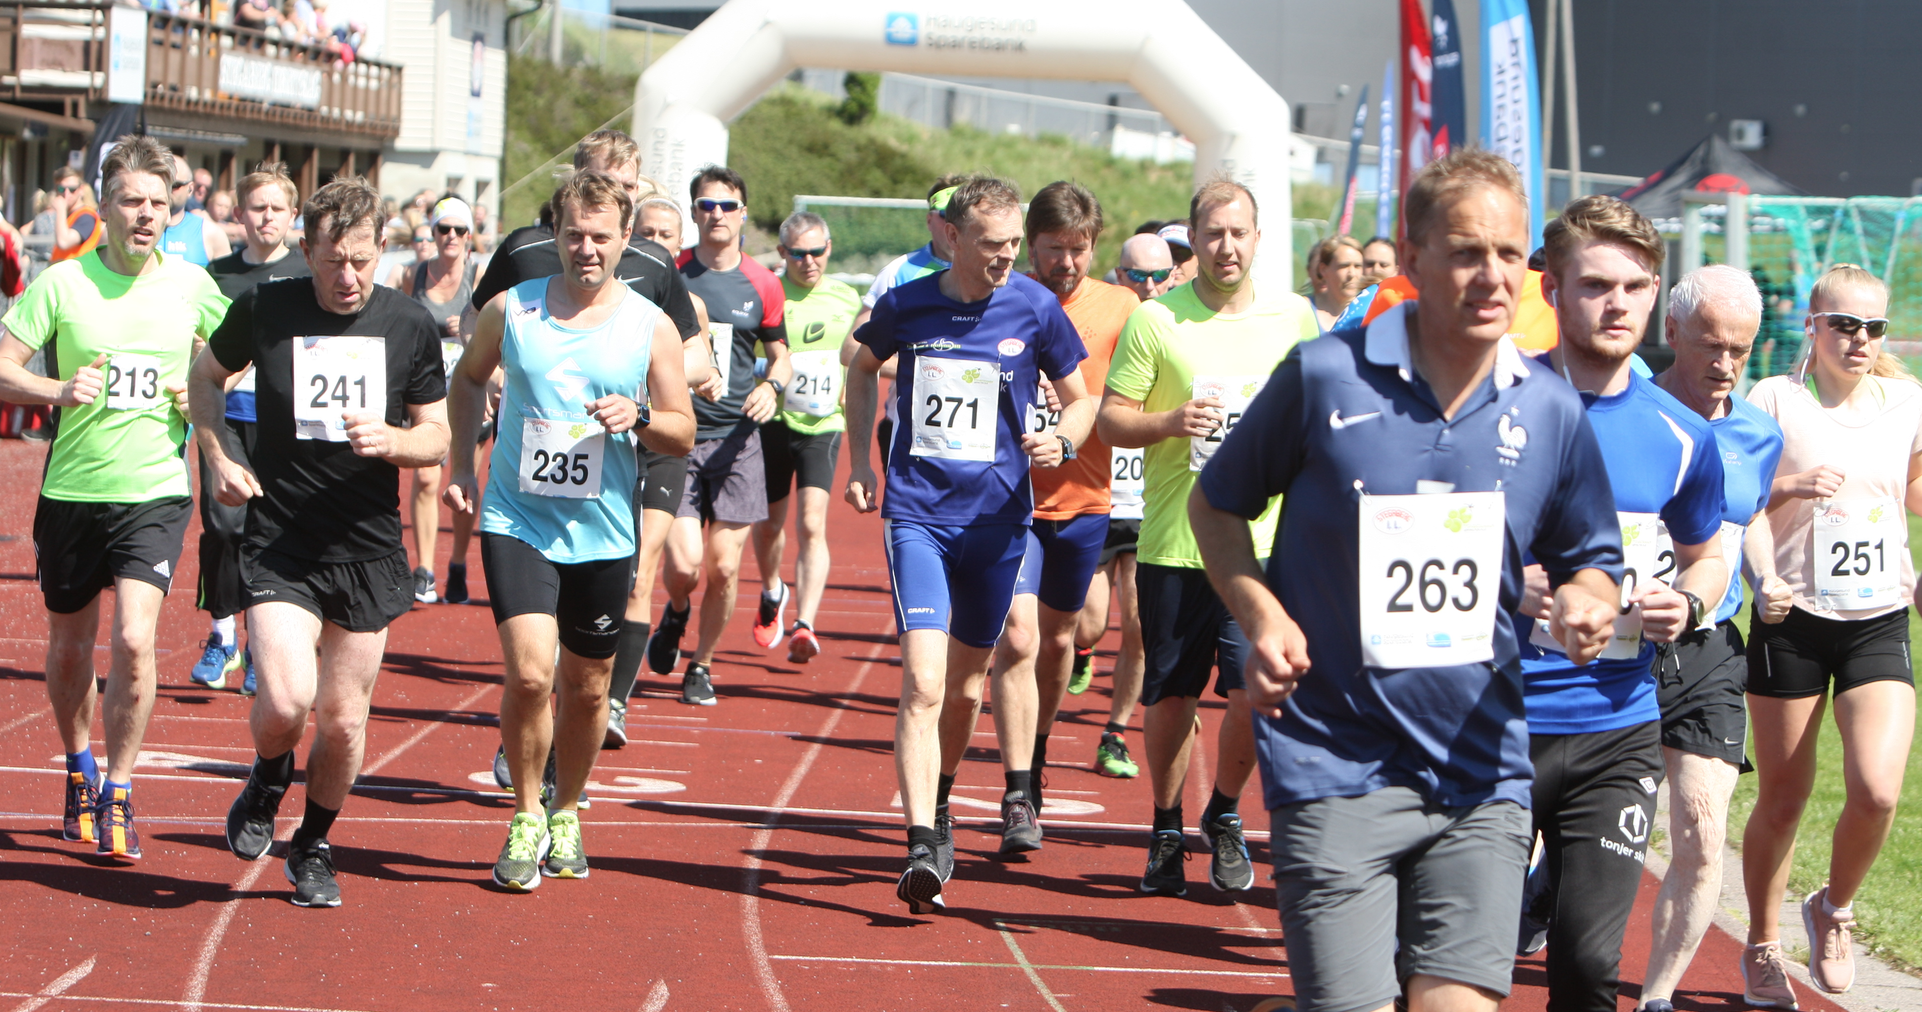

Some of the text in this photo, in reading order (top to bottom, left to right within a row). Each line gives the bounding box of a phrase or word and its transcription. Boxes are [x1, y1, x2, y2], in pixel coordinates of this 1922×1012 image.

[926, 12, 1037, 32] Haugesund
[925, 31, 1028, 52] Sparebank
[951, 315, 975, 323] CRAFT
[107, 364, 159, 400] 213
[310, 373, 366, 408] 241
[796, 374, 832, 395] 214
[925, 393, 979, 429] 271
[1035, 404, 1061, 432] 54
[1205, 407, 1241, 442] 25
[532, 448, 589, 485] 235
[1115, 455, 1143, 481] 20
[1830, 537, 1885, 577] 251
[1386, 558, 1478, 613] 263
[1600, 836, 1634, 857] tonjer
